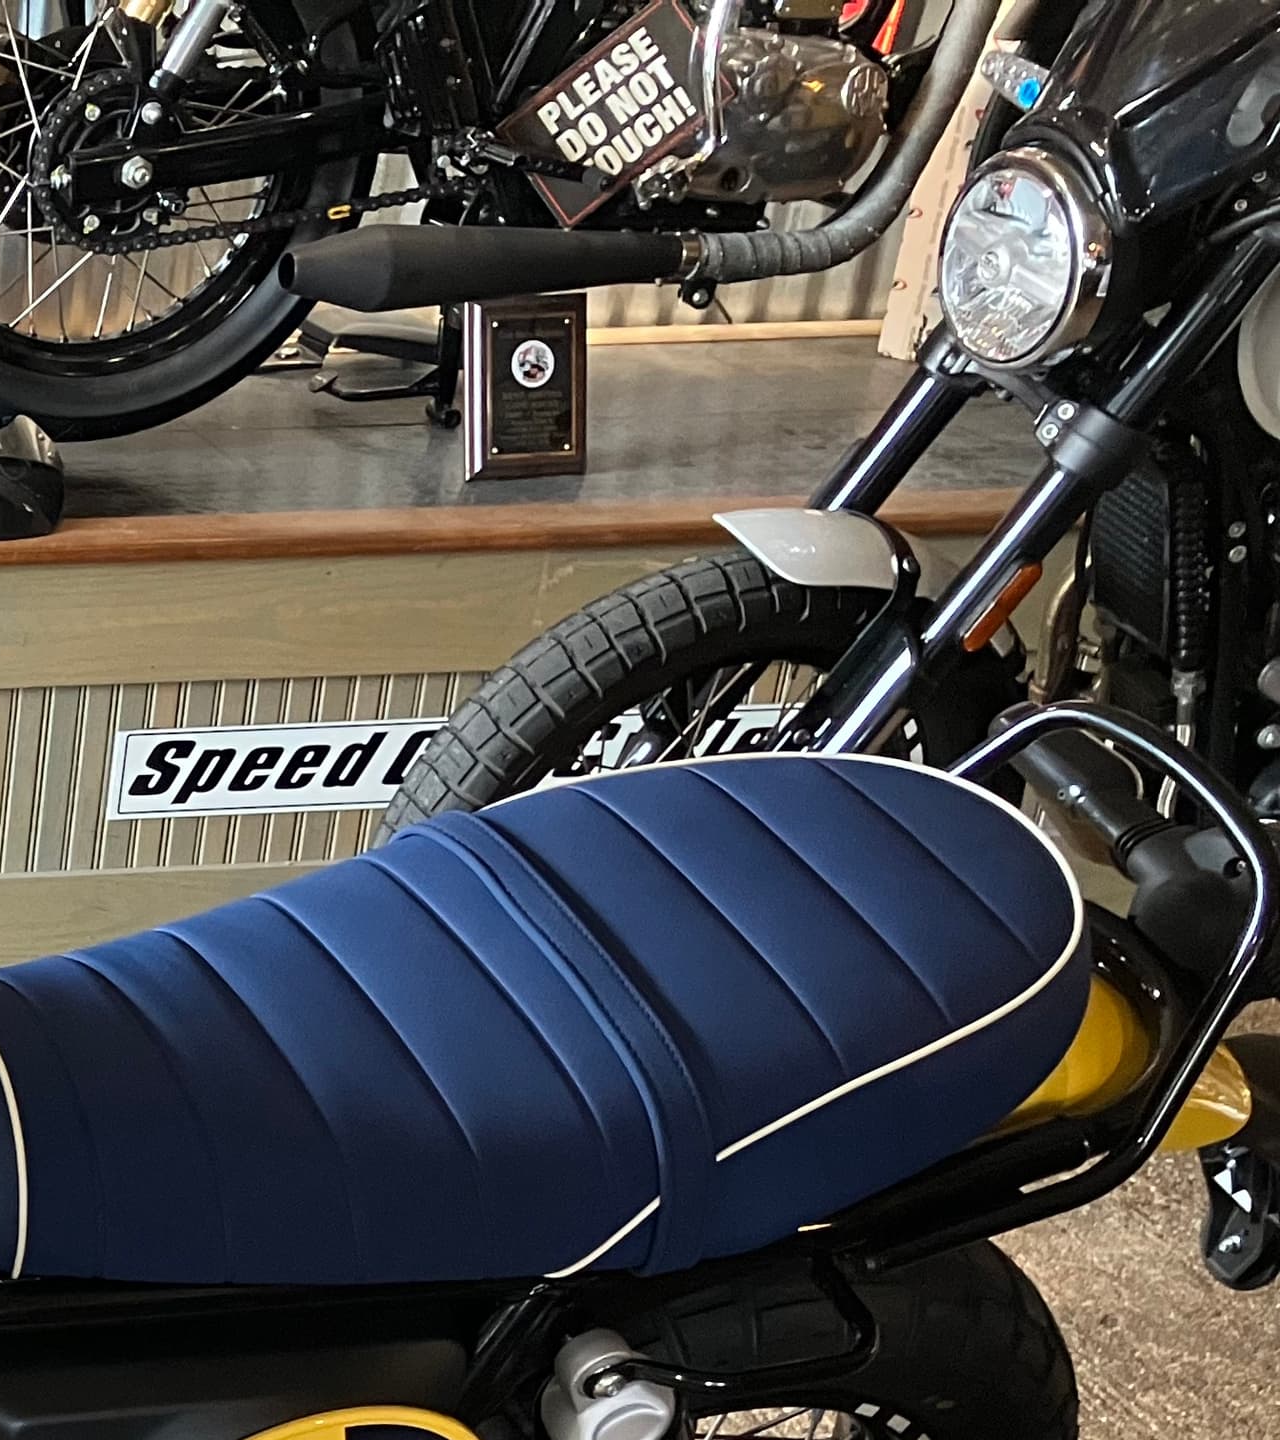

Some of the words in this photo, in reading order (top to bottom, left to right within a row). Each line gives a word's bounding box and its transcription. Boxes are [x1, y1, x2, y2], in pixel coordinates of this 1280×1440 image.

[537, 27, 659, 136] PLEASE
[556, 112, 607, 162] DO
[605, 55, 675, 125] NOT
[583, 86, 697, 175] OUCH!
[128, 731, 389, 805] Speed
